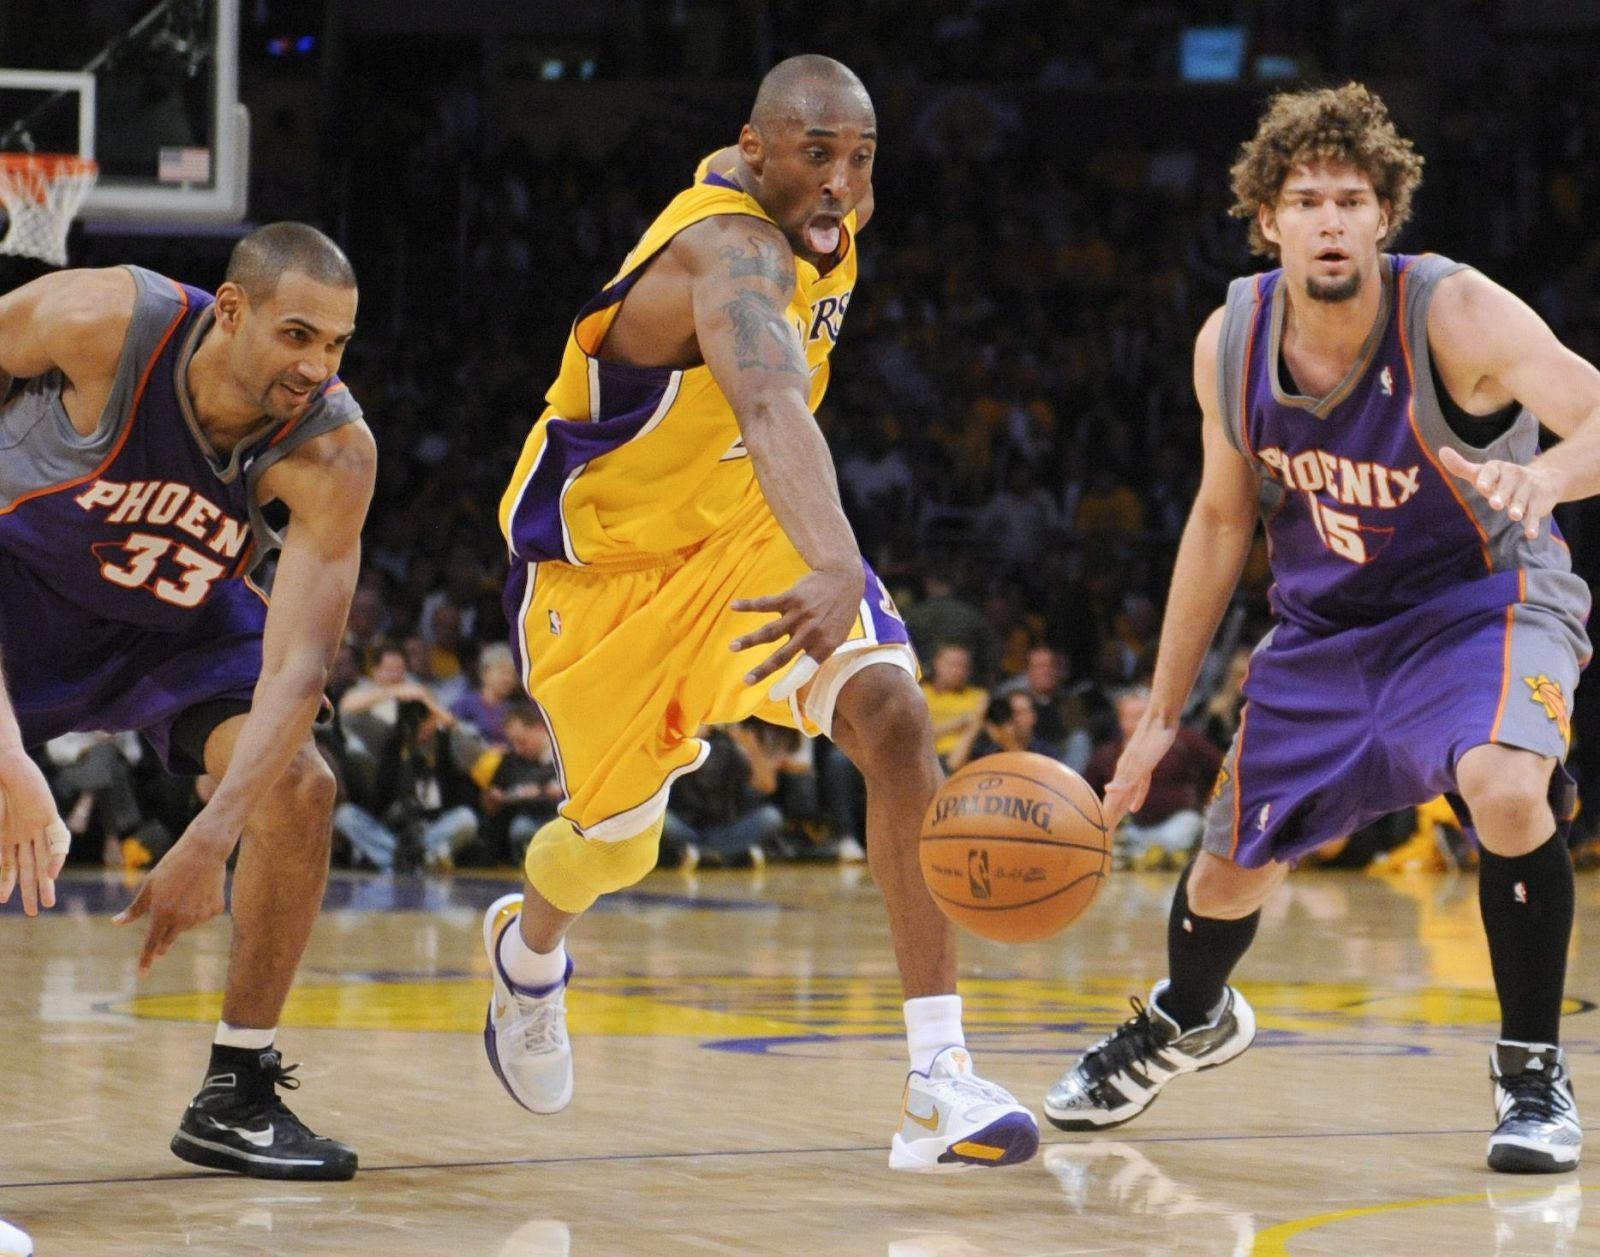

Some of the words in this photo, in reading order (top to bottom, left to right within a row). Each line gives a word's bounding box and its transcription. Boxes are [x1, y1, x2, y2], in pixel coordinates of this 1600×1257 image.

[1309, 491, 1367, 564] 15
[101, 532, 226, 608] 33
[931, 795, 1053, 834] SPALDING
